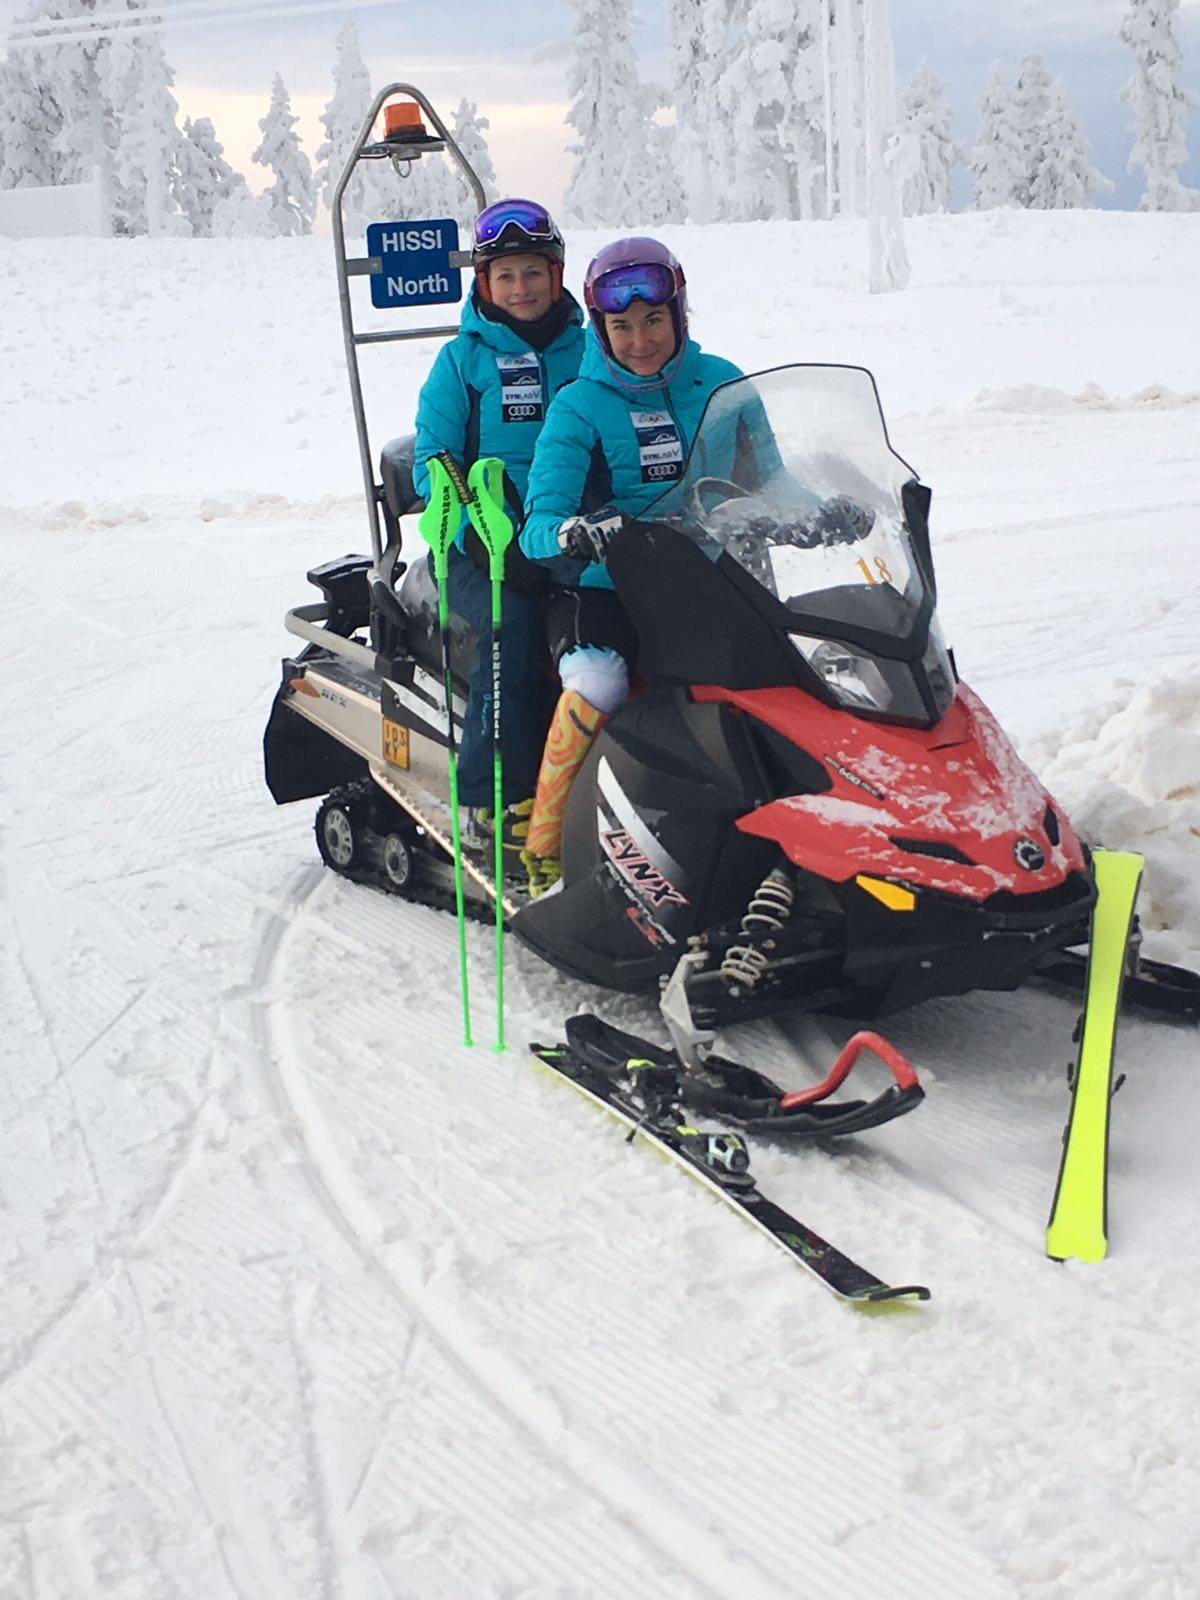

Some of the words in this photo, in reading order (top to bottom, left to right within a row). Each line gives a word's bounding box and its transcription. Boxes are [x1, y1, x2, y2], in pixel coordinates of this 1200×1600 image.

[382, 229, 442, 253] HISSI
[387, 273, 449, 297] North
[857, 556, 893, 587] 18
[492, 641, 501, 739] KOMPERDELL
[602, 830, 688, 906] LYNX
